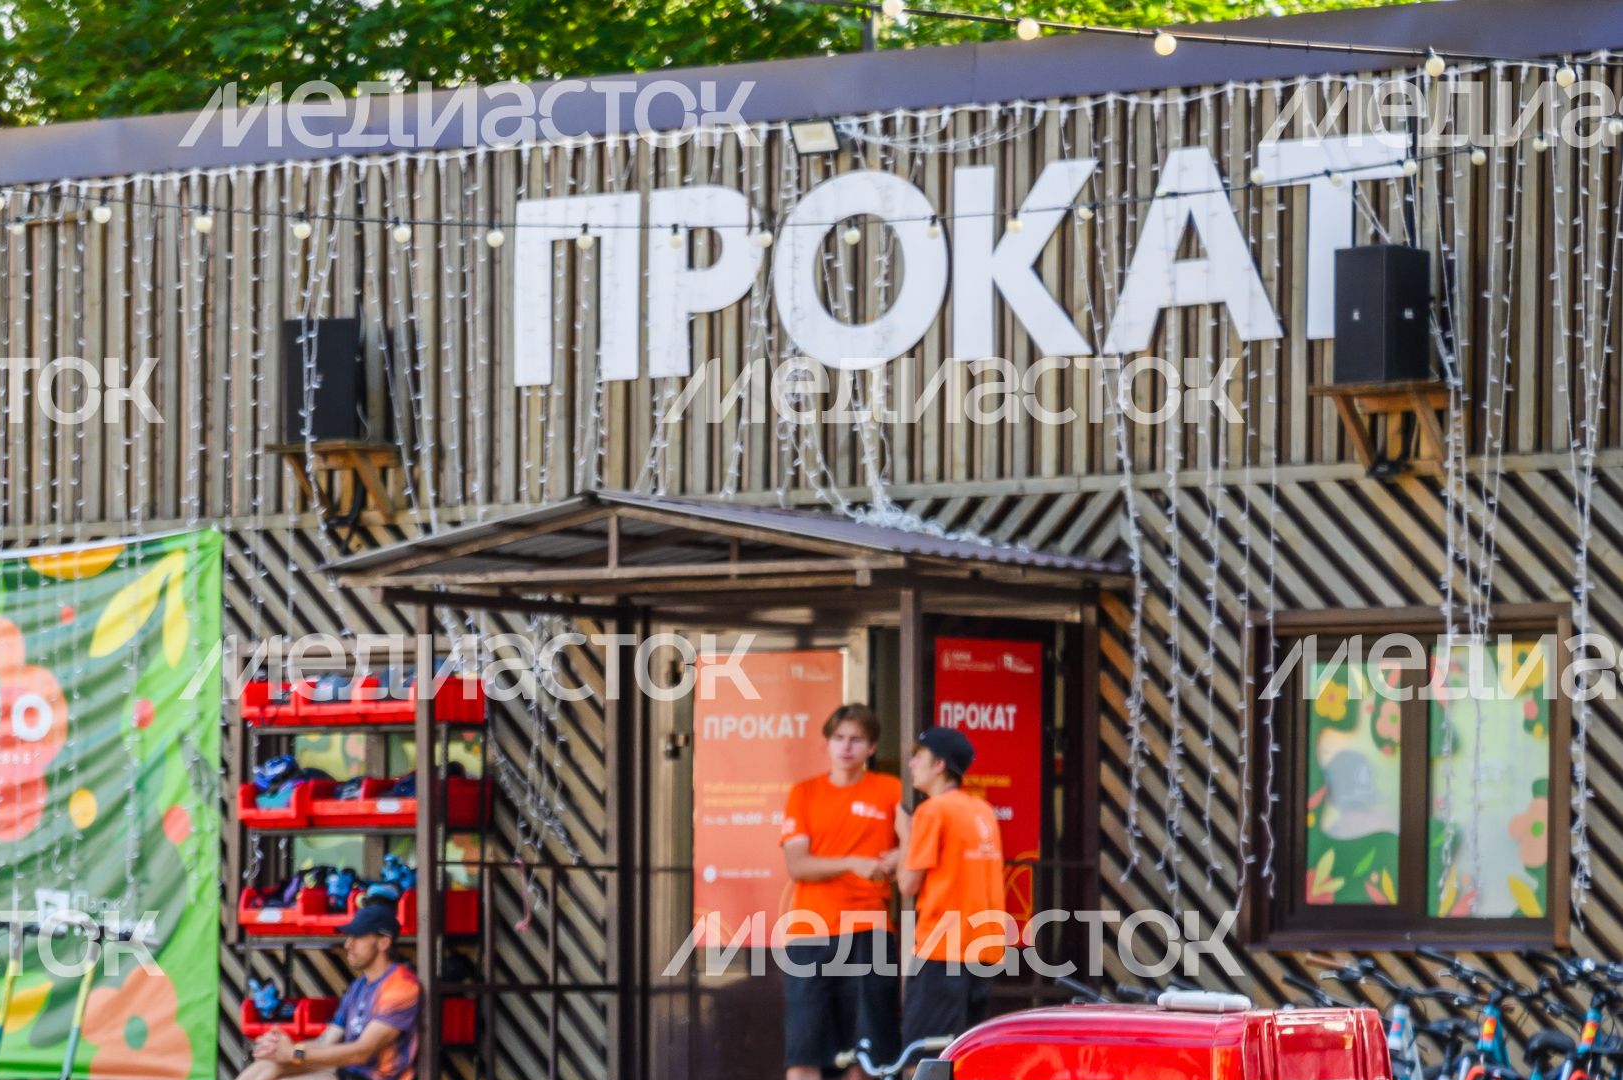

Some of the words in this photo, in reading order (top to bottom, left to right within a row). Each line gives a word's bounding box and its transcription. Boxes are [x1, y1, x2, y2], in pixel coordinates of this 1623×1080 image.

[515, 132, 1414, 387] ПРОКАТ
[703, 714, 809, 740] ПРОКАТ
[940, 701, 1017, 731] ПРОКАТ
